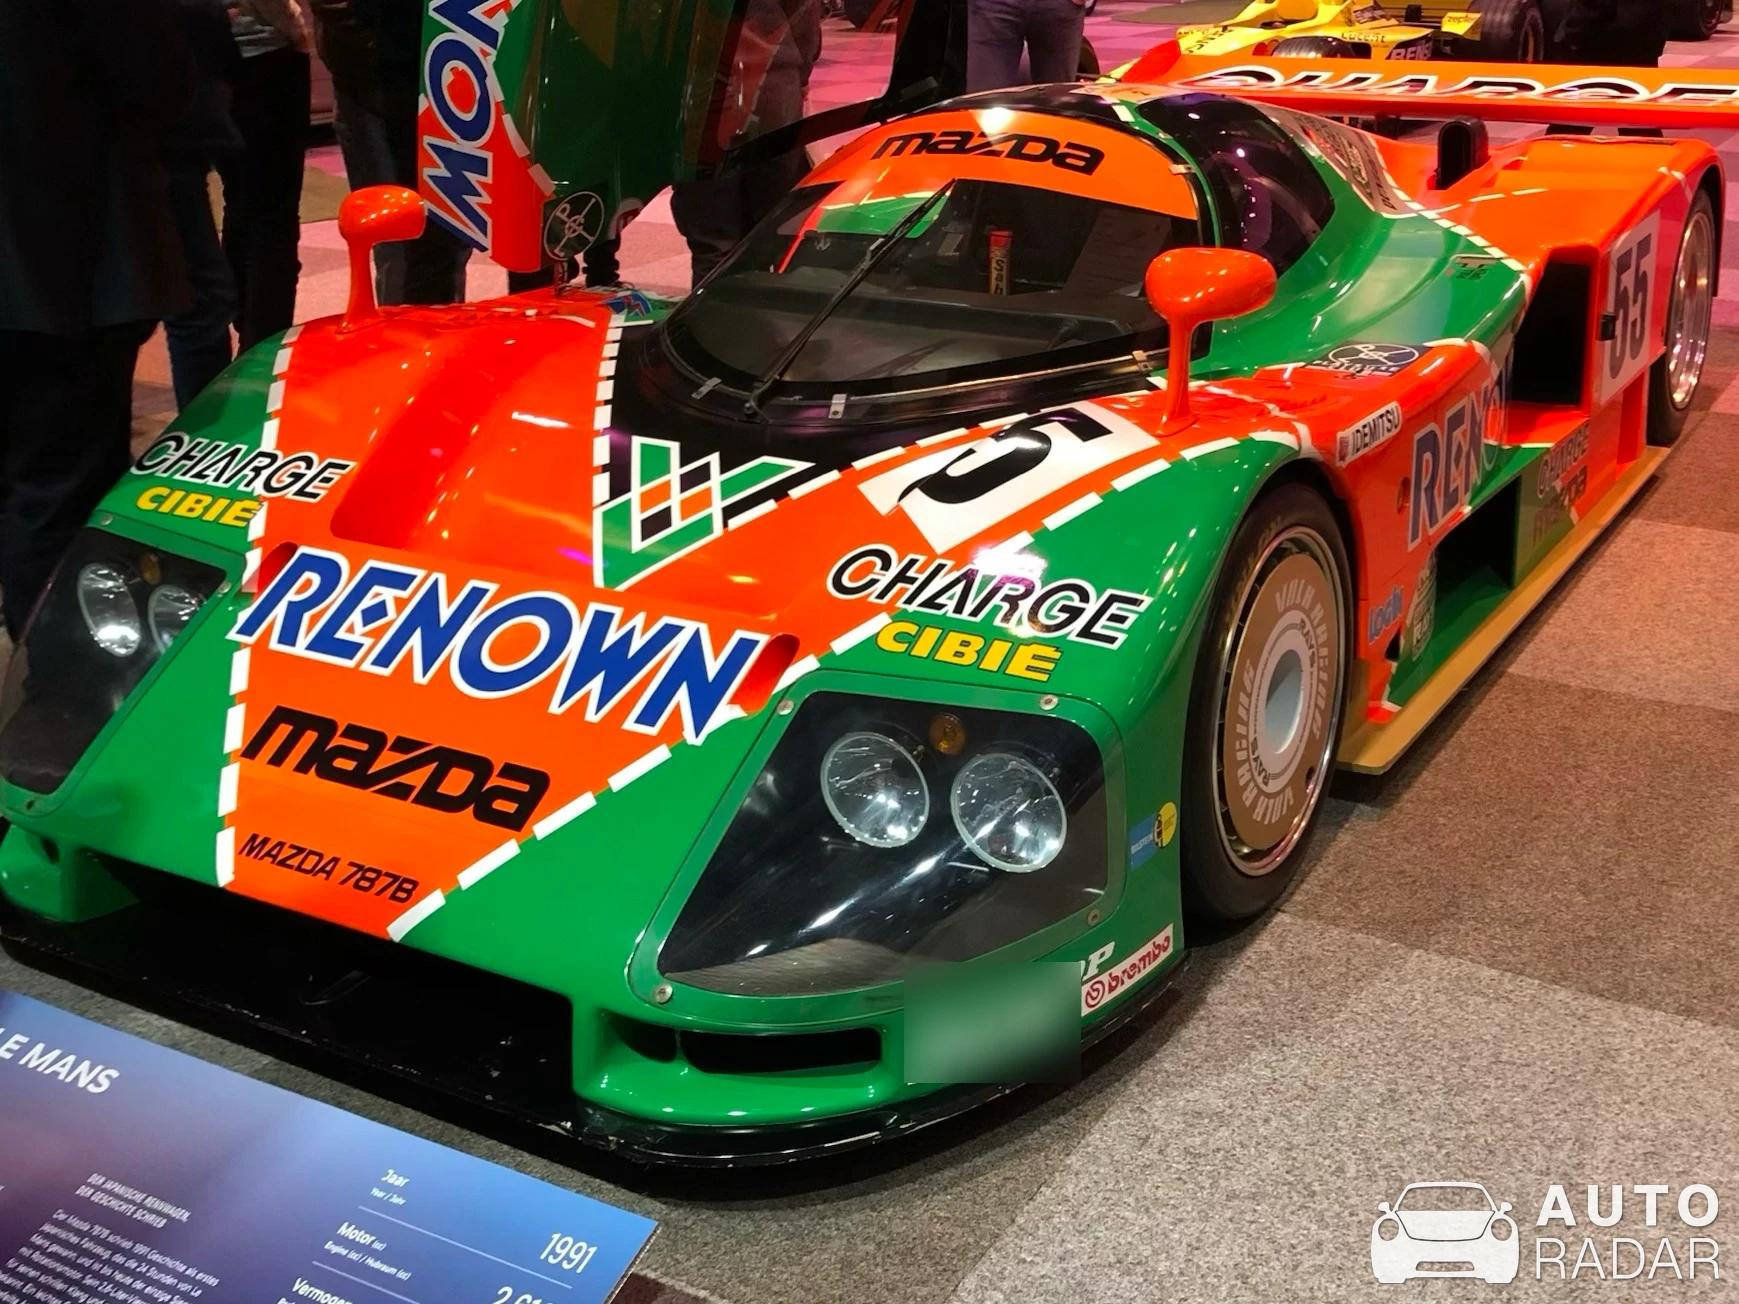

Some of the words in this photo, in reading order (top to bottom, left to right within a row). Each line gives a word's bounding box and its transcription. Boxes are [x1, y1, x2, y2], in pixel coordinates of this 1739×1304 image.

[1609, 232, 1652, 380] 55
[1350, 404, 1402, 455] IDEMITSU
[131, 431, 357, 503] CHARGE
[826, 543, 1154, 650] CHARGE
[227, 544, 770, 745] RENOWN
[238, 832, 345, 884] MAZDA
[339, 862, 419, 904] 787B
[1107, 934, 1171, 995] brembo
[0, 1027, 30, 1060] E
[18, 1042, 120, 1093] MANS
[381, 1168, 410, 1188] Jaar
[336, 1221, 377, 1246] Motor
[540, 1232, 598, 1274] 1991
